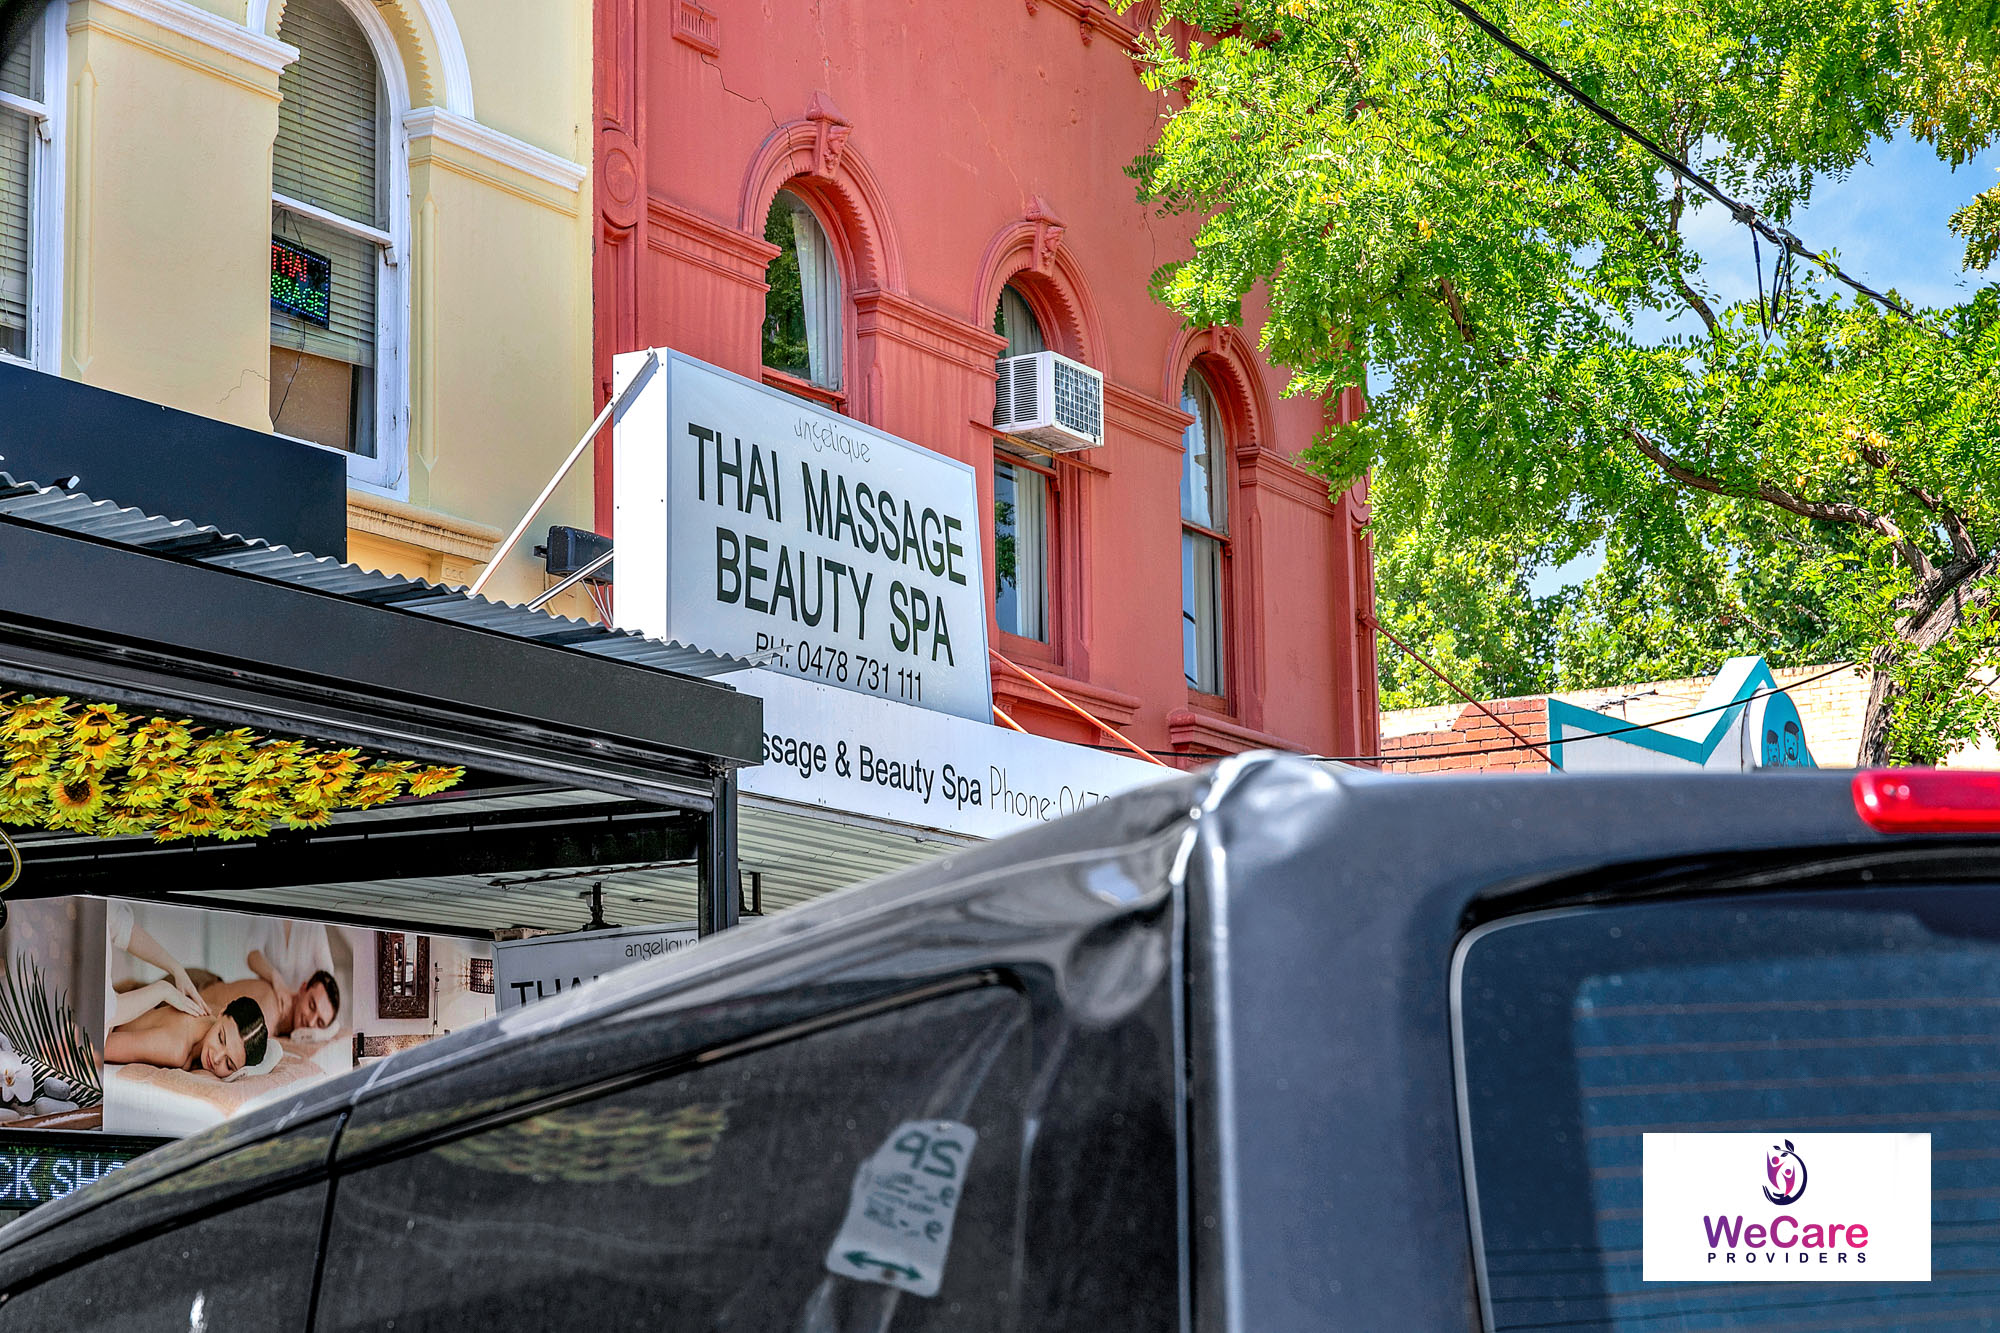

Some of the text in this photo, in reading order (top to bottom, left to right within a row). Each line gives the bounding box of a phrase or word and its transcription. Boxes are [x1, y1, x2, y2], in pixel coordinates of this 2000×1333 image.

[688, 422, 967, 587] THAI MASSAGE
[716, 526, 955, 667] BEAUTY SPA
[798, 641, 848, 682] 0478
[856, 655, 889, 693] 731
[898, 667, 921, 701] 111
[835, 740, 852, 779] &
[859, 745, 934, 804] Beauty
[942, 764, 982, 811] Spa
